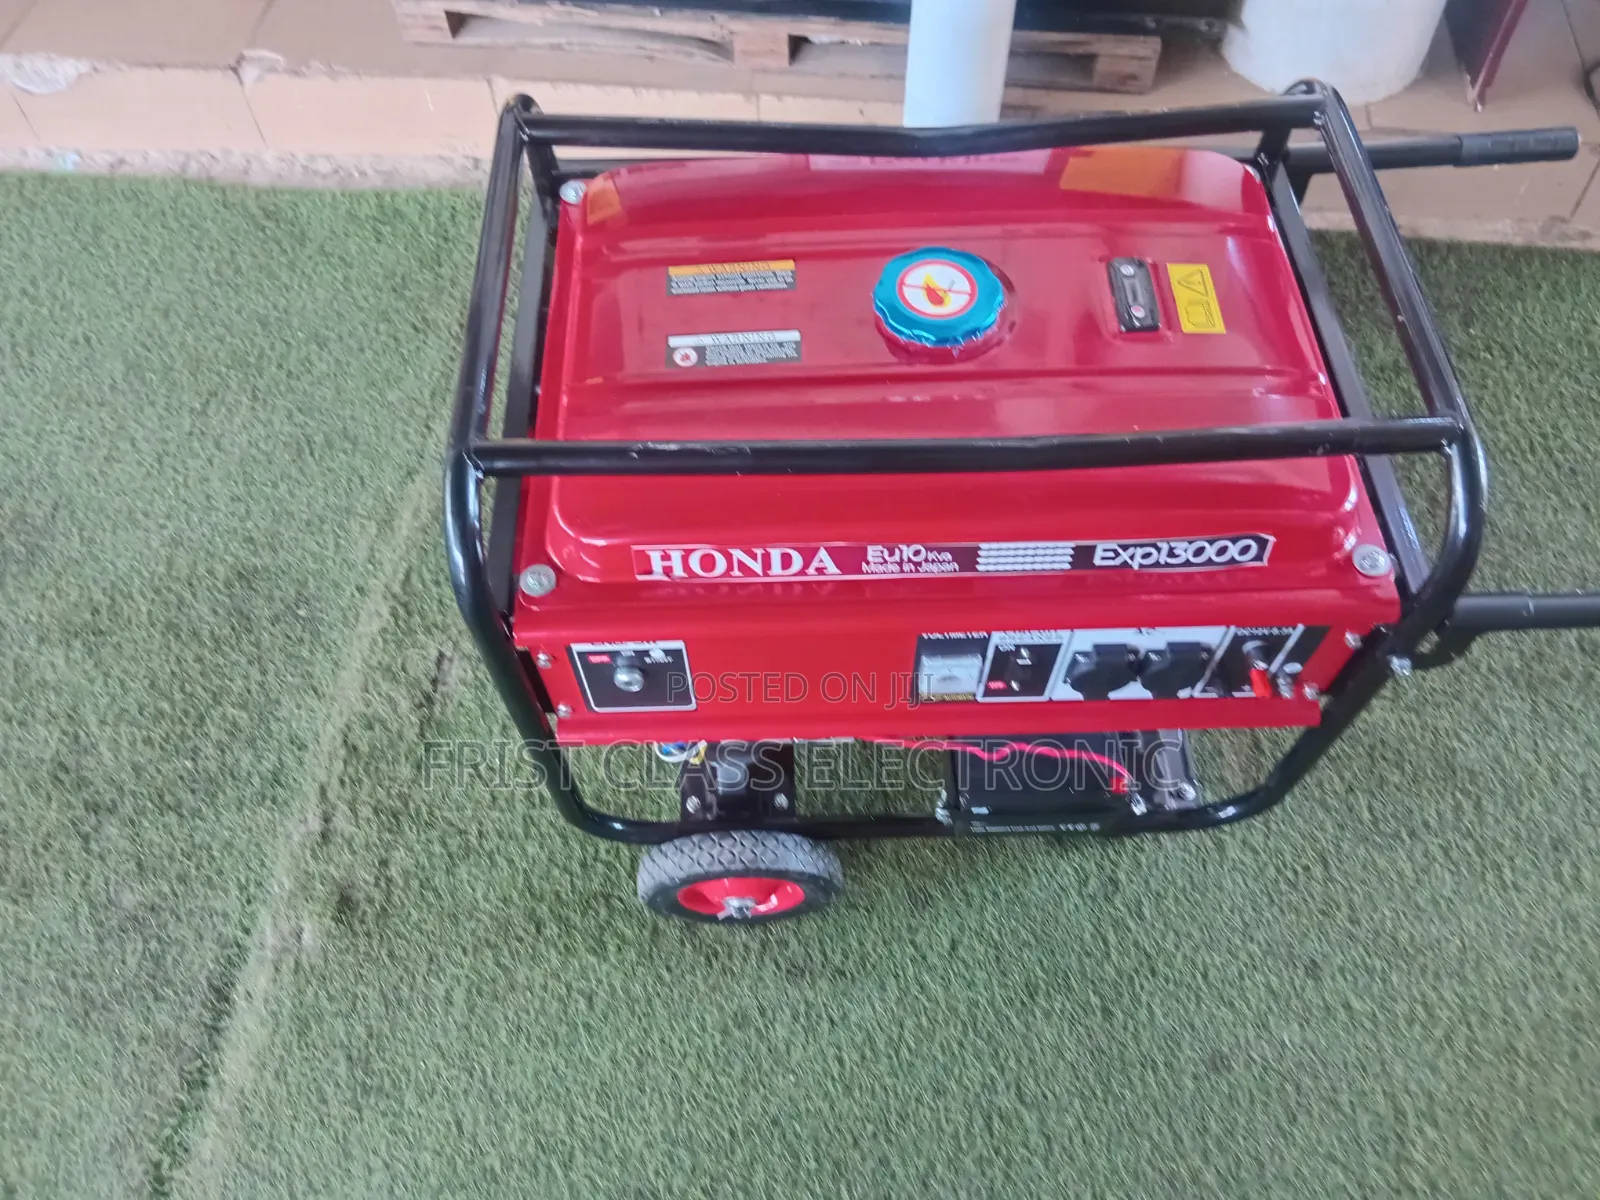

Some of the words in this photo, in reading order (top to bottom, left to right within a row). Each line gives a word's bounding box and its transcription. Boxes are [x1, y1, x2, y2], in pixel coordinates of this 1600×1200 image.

[645, 546, 842, 578] HONDA
[862, 562, 900, 574] Made
[902, 562, 915, 573] in
[917, 561, 959, 574] Japan
